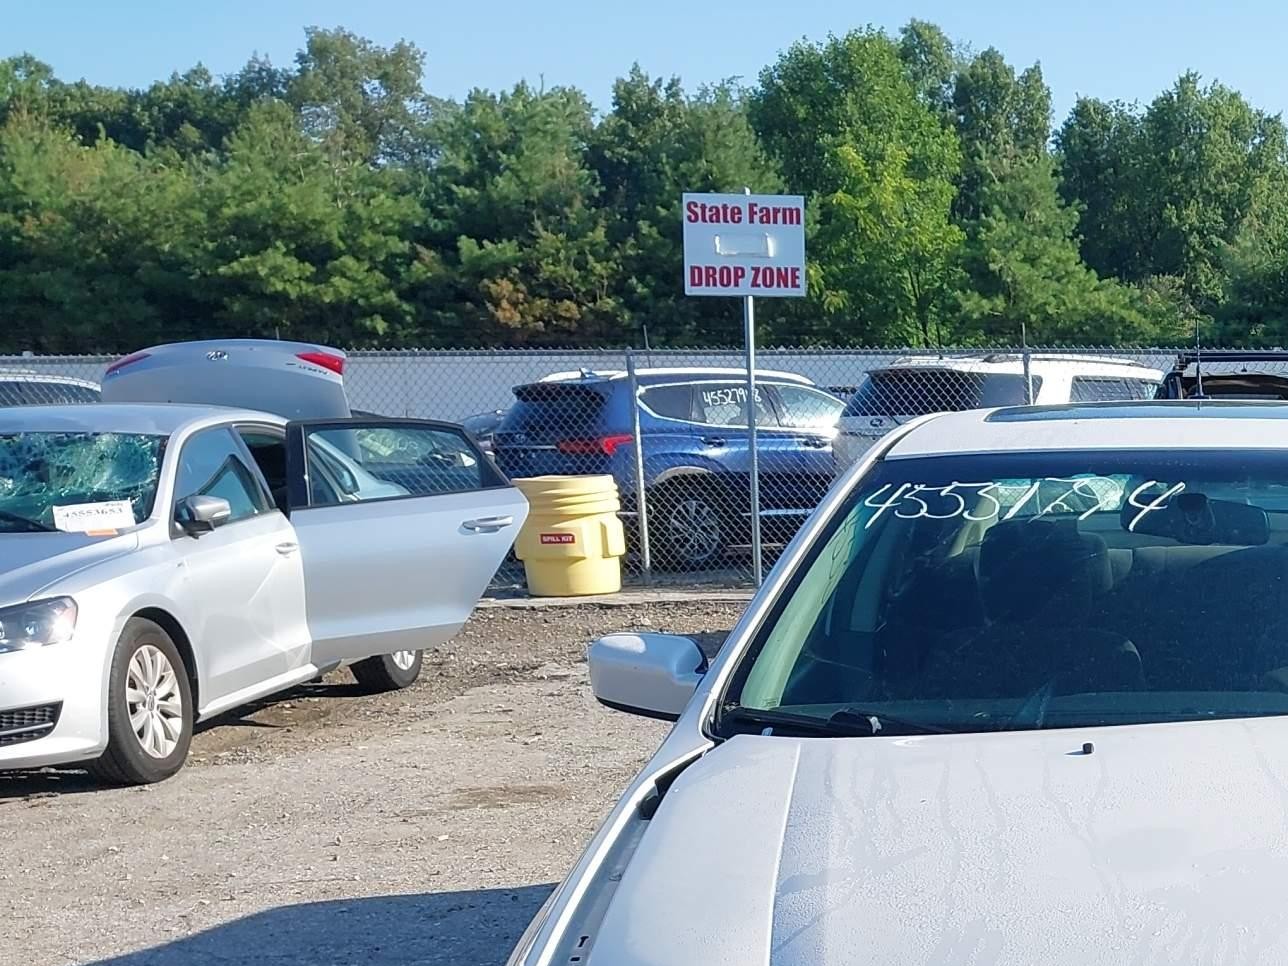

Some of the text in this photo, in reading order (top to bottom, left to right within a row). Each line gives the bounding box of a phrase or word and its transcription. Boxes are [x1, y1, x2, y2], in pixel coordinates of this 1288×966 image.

[686, 201, 801, 225] State Farm
[690, 265, 801, 289] DROP ZONE
[702, 387, 762, 407] 4552798
